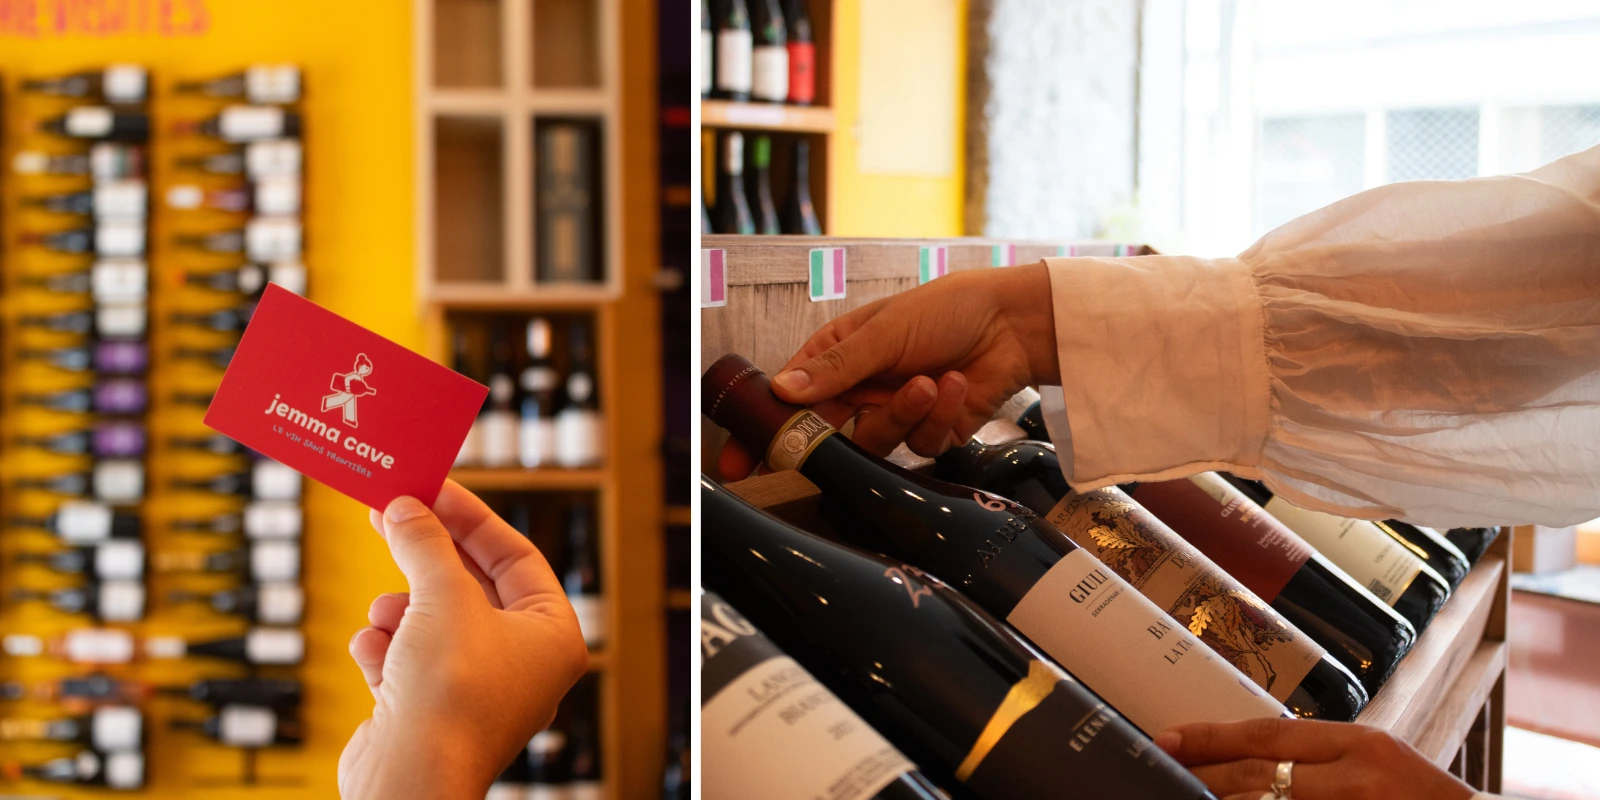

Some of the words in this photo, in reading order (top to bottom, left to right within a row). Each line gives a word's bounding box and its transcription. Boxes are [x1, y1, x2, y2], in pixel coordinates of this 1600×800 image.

[265, 394, 341, 443] jemma
[343, 435, 395, 470] cave
[272, 424, 284, 434] LE
[303, 438, 325, 455] SANS
[1069, 569, 1111, 604] GIULI
